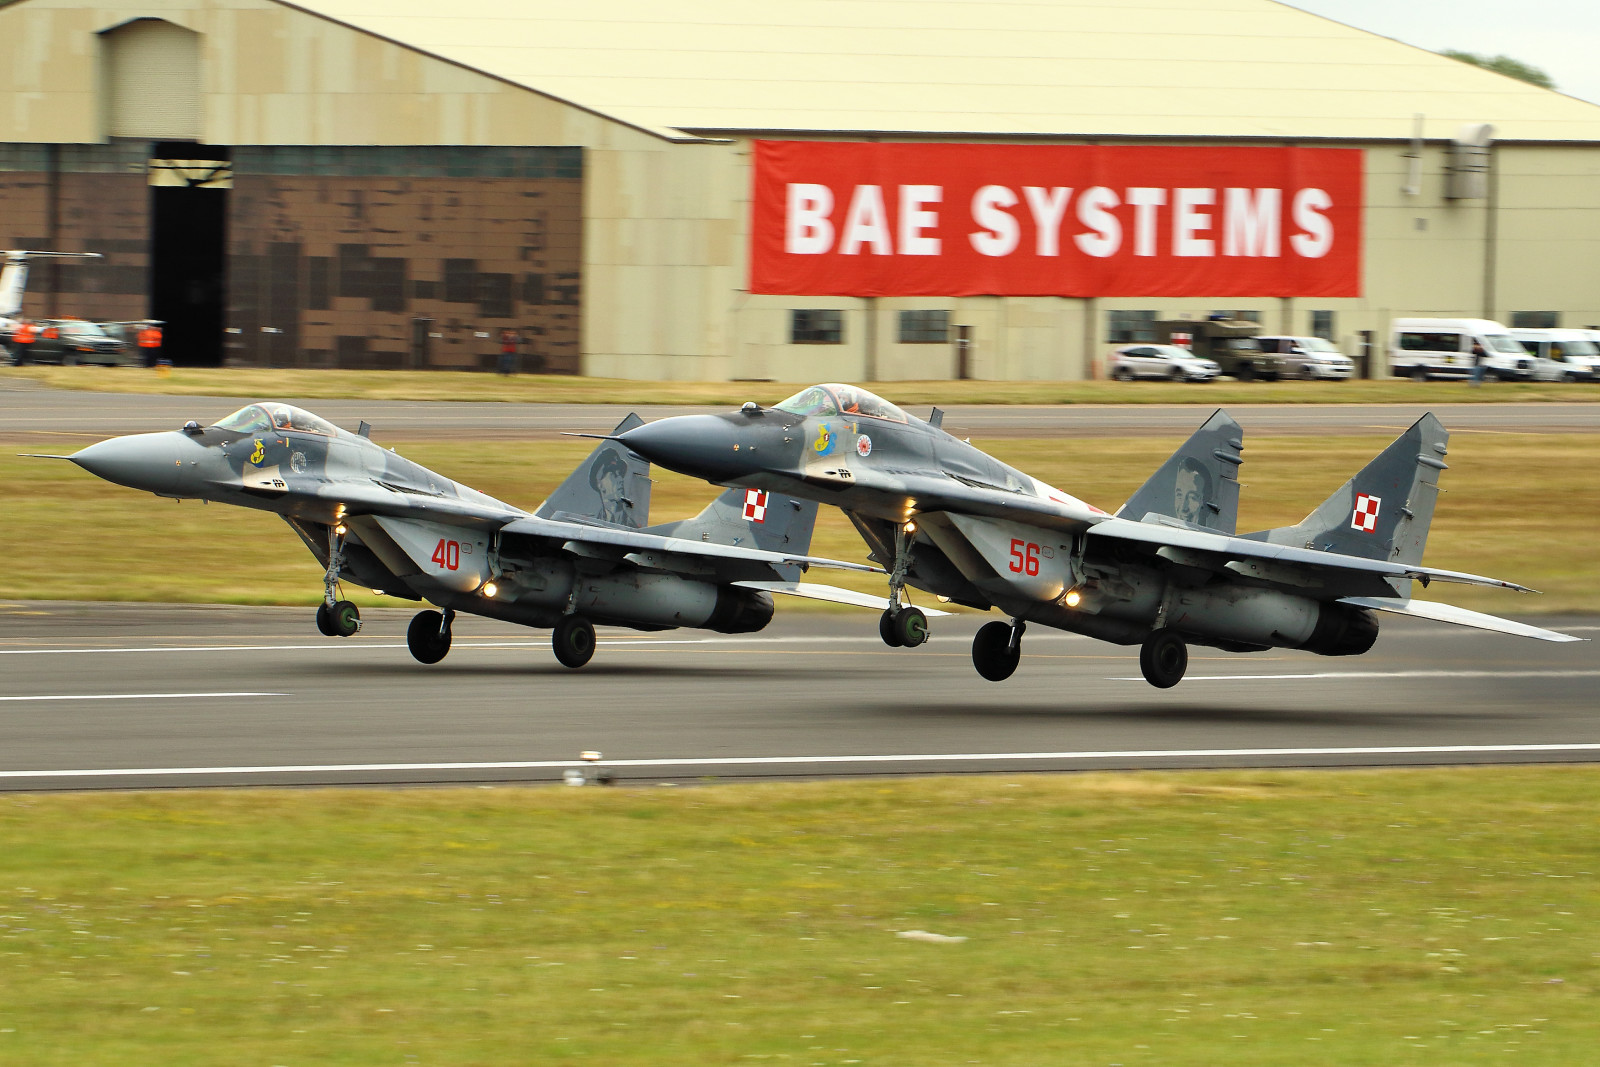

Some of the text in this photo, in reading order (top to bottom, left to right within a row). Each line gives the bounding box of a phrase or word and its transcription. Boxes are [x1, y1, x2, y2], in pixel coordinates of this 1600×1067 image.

[785, 182, 1334, 258] BAE SYSTEMS
[431, 538, 460, 571] 40
[1009, 538, 1040, 577] 56
